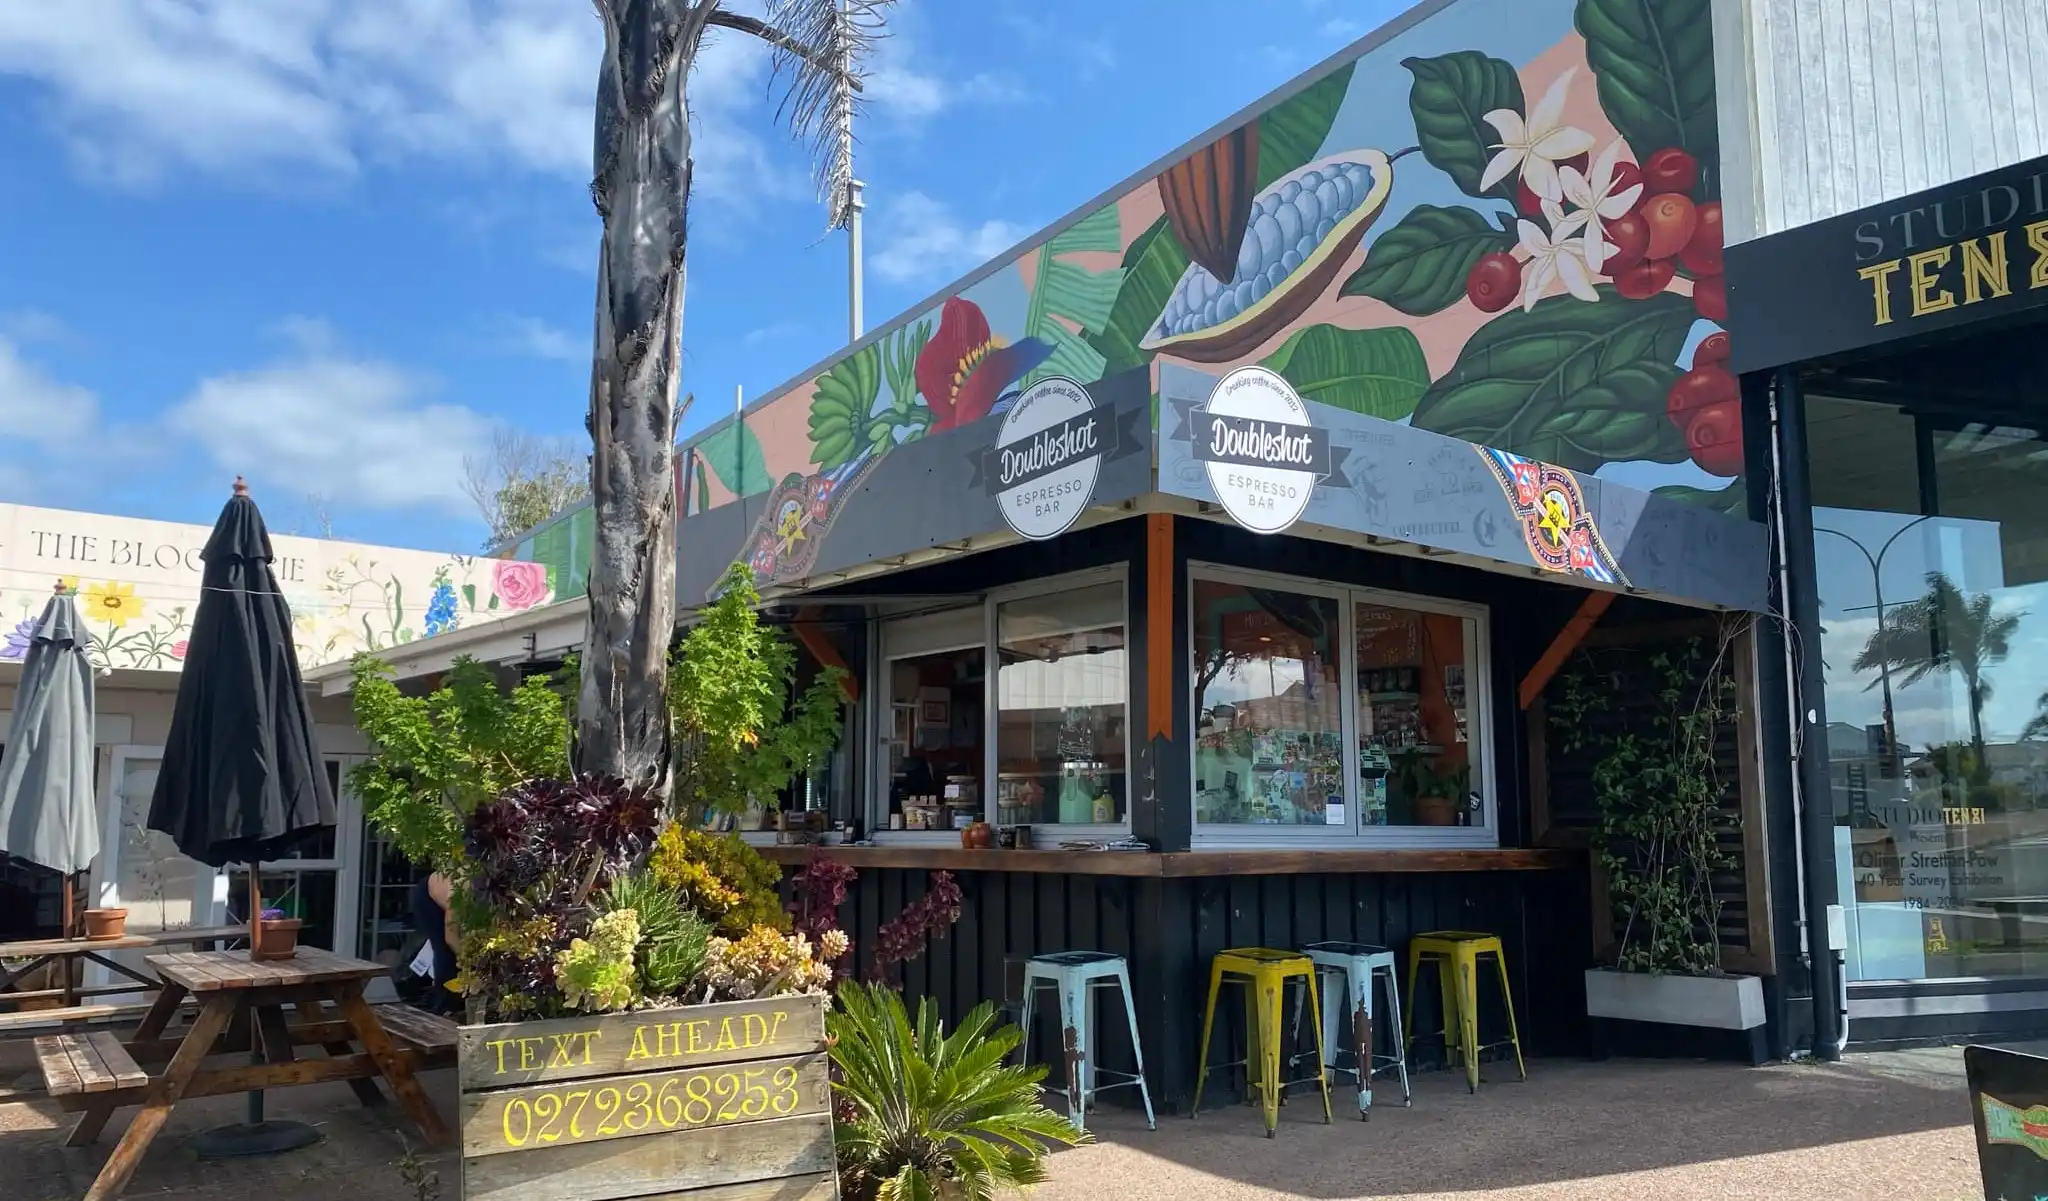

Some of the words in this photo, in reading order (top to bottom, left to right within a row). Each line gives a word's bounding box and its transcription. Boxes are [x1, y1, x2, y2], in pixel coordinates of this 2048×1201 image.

[1000, 418, 1098, 485] Doubleshot
[1211, 418, 1313, 465] Doubleshot
[1016, 480, 1083, 507] ESPRESSO
[1228, 474, 1297, 499] ESPRESSO
[1035, 500, 1061, 517] BAR
[1248, 494, 1275, 510] BAR
[31, 530, 98, 562] THE
[1872, 806, 1941, 824] TUDIO
[1880, 873, 1905, 887] Year
[1909, 873, 1947, 889] Survey
[486, 1030, 602, 1074] TEXT
[626, 1011, 788, 1062] AHEAD!
[502, 1066, 800, 1147] 0272368253
